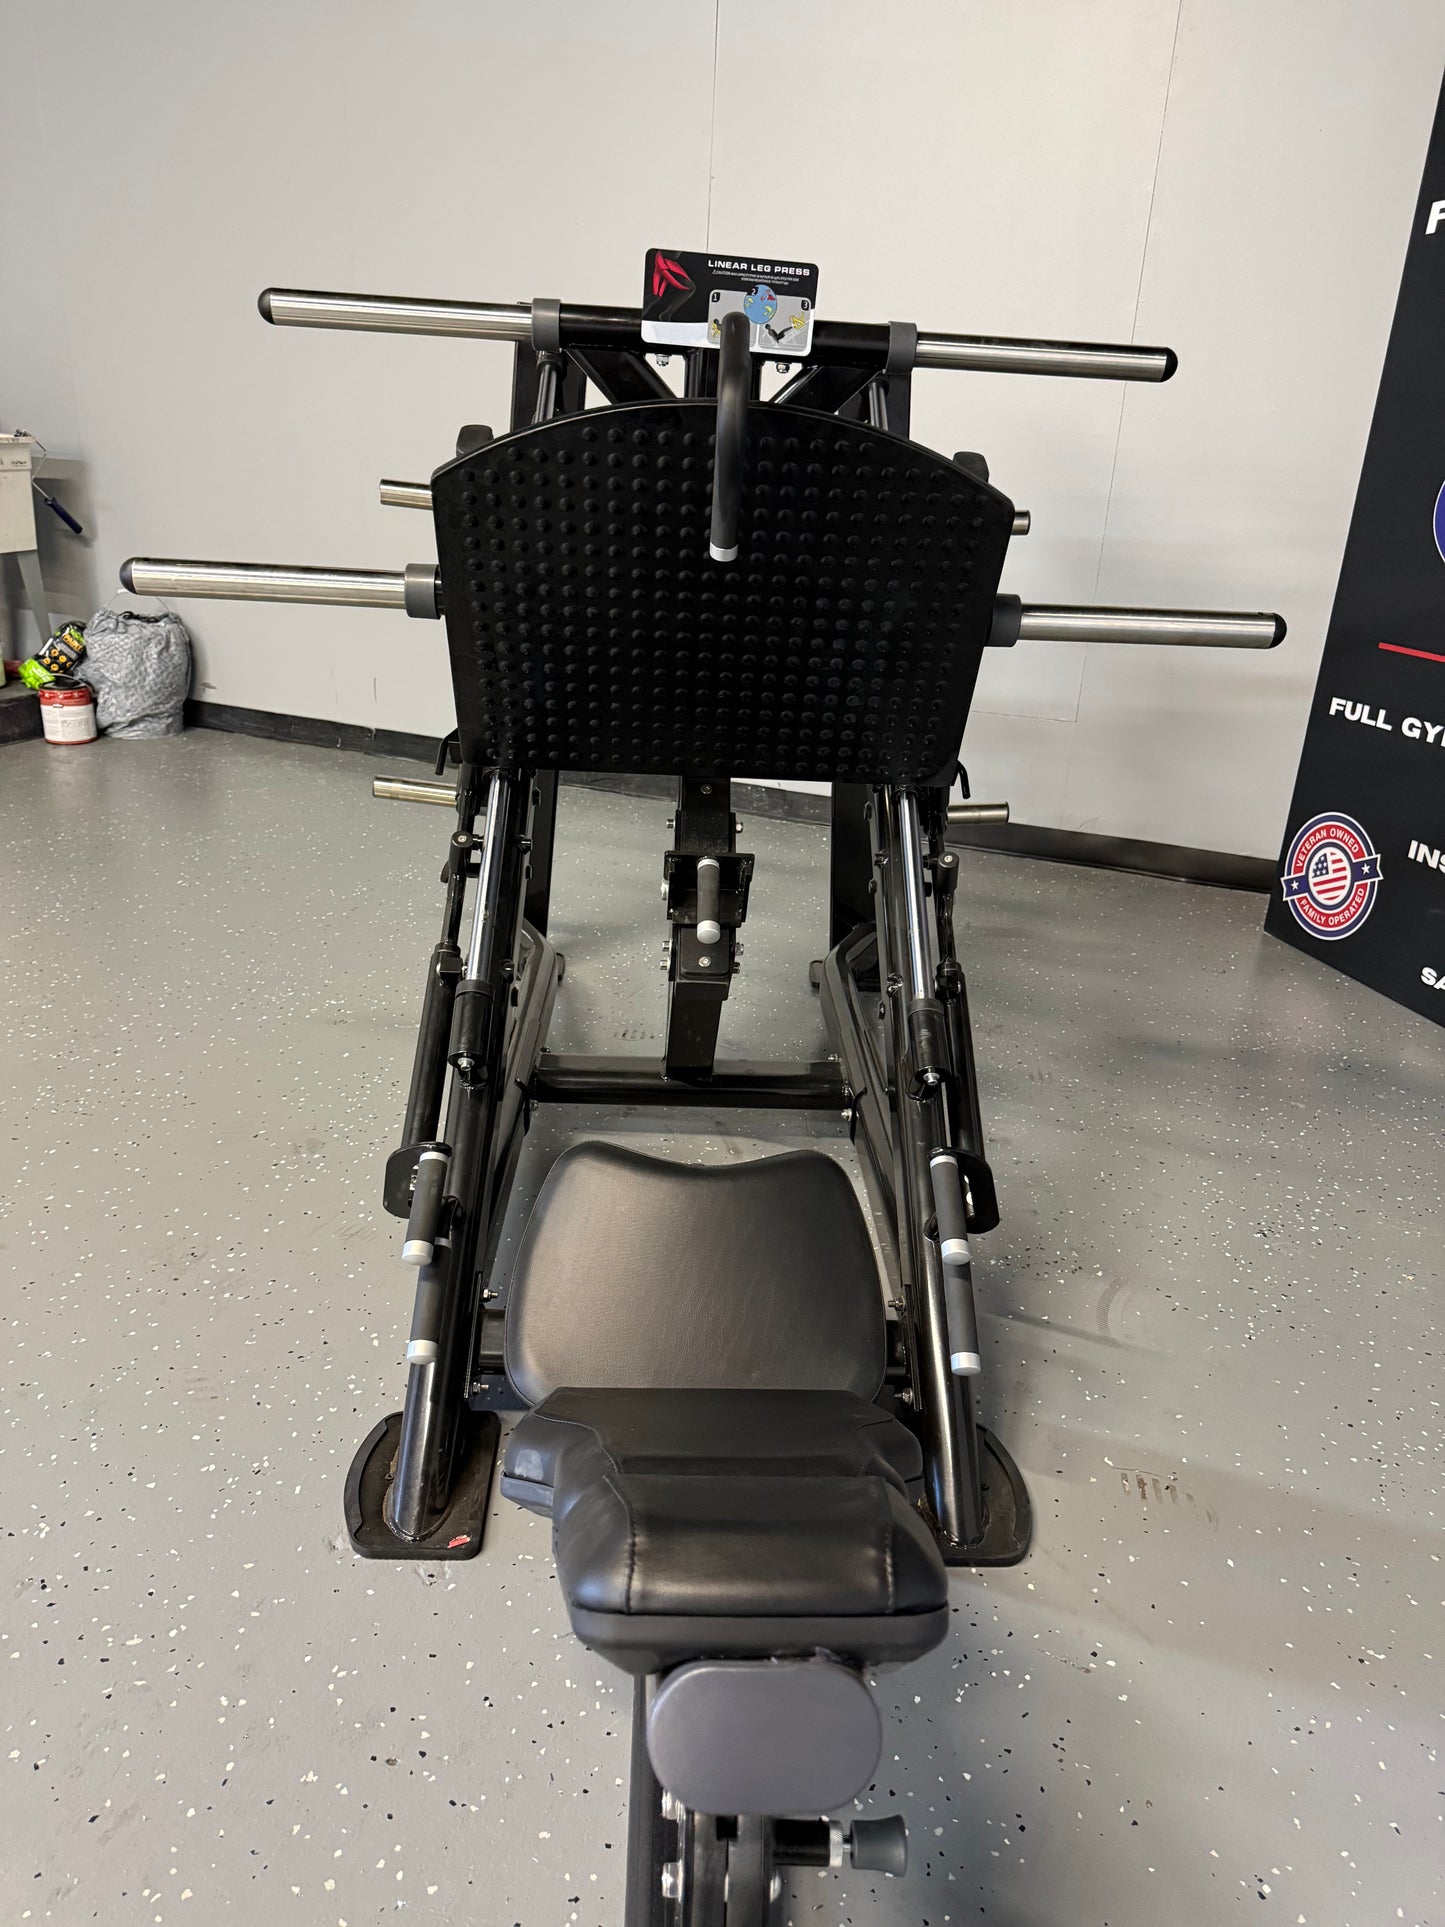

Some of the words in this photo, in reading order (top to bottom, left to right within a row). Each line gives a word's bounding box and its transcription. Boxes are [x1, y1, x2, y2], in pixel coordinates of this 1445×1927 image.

[708, 260, 747, 270] LINEAR
[751, 264, 771, 273] LEG
[774, 265, 810, 276] PRESS
[713, 293, 718, 301] 1
[751, 288, 757, 296] 2
[803, 301, 809, 309] 3
[1329, 697, 1393, 731] FULL
[1401, 717, 1445, 748] GY
[1296, 829, 1327, 867] VETERAN
[1329, 827, 1359, 854] OWNED
[1300, 898, 1327, 925] FAMILY
[1328, 887, 1365, 926] OPERATED
